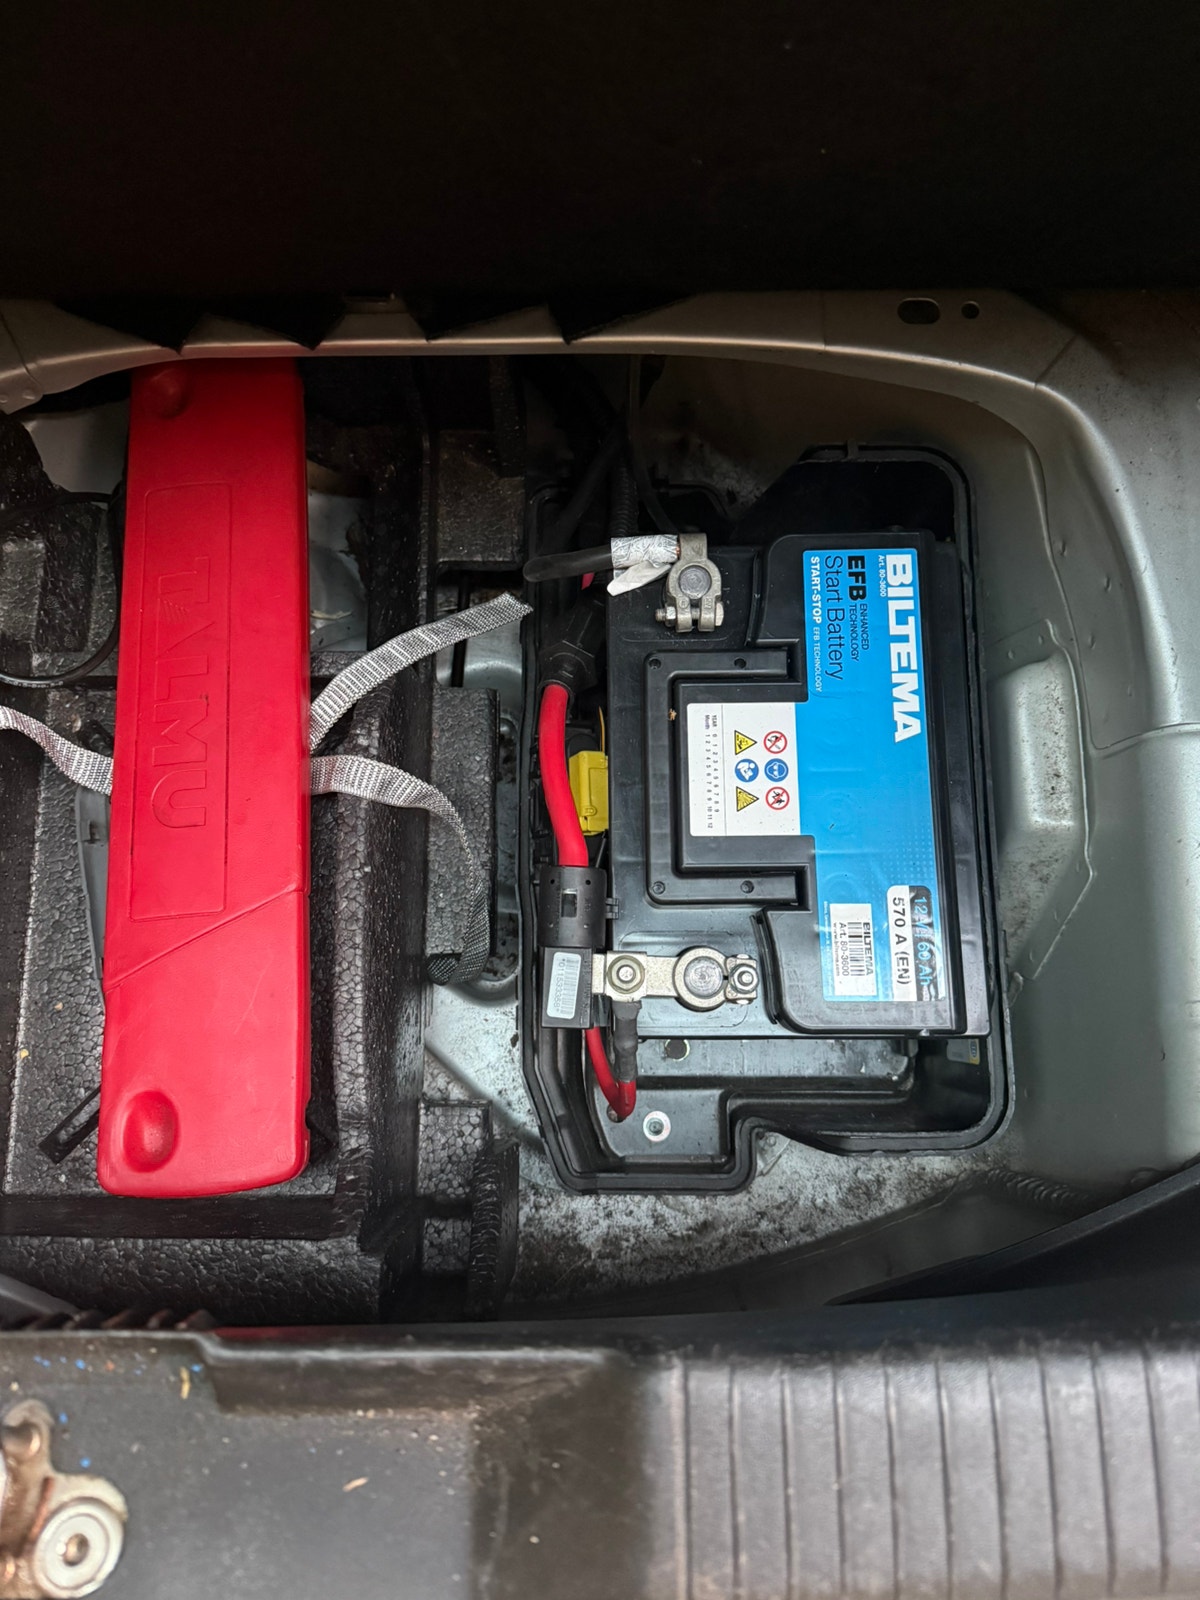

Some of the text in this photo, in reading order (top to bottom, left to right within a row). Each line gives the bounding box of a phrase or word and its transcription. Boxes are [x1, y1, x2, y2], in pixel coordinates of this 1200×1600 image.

[811, 556, 822, 624] START-STOP
[848, 555, 867, 601] EFB
[879, 570, 887, 597] 80-3600
[825, 555, 845, 680] Start Battery
[849, 604, 859, 661] TECHNOLOGY
[860, 603, 869, 650] ENHANCED
[813, 643, 823, 692] TECHNOLOGY
[885, 554, 922, 743] BILTEMA
[152, 556, 215, 829] TALMU
[914, 897, 928, 914] 12
[839, 922, 849, 976] Art. 80-3600
[863, 922, 874, 976] BILTEMA
[893, 897, 911, 985] 570 A (EN)
[917, 942, 931, 961] 60
[919, 964, 933, 986] Ah
